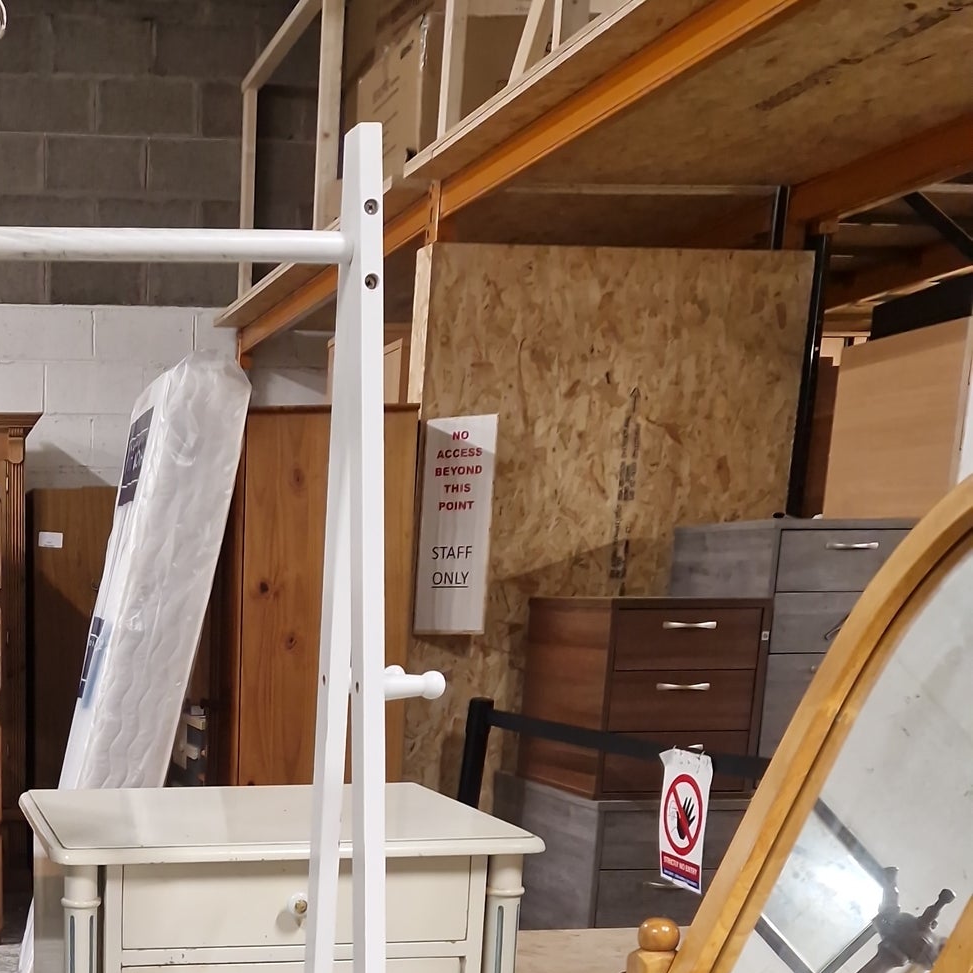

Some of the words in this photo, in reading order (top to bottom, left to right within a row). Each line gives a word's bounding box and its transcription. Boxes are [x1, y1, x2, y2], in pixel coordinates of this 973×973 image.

[452, 431, 469, 441] NO
[437, 447, 483, 459] ACCESS
[435, 465, 483, 477] BEYOND
[445, 483, 472, 493] THIS
[438, 500, 475, 511] POINT
[432, 545, 473, 560] STAFF
[432, 571, 470, 585] ONLY
